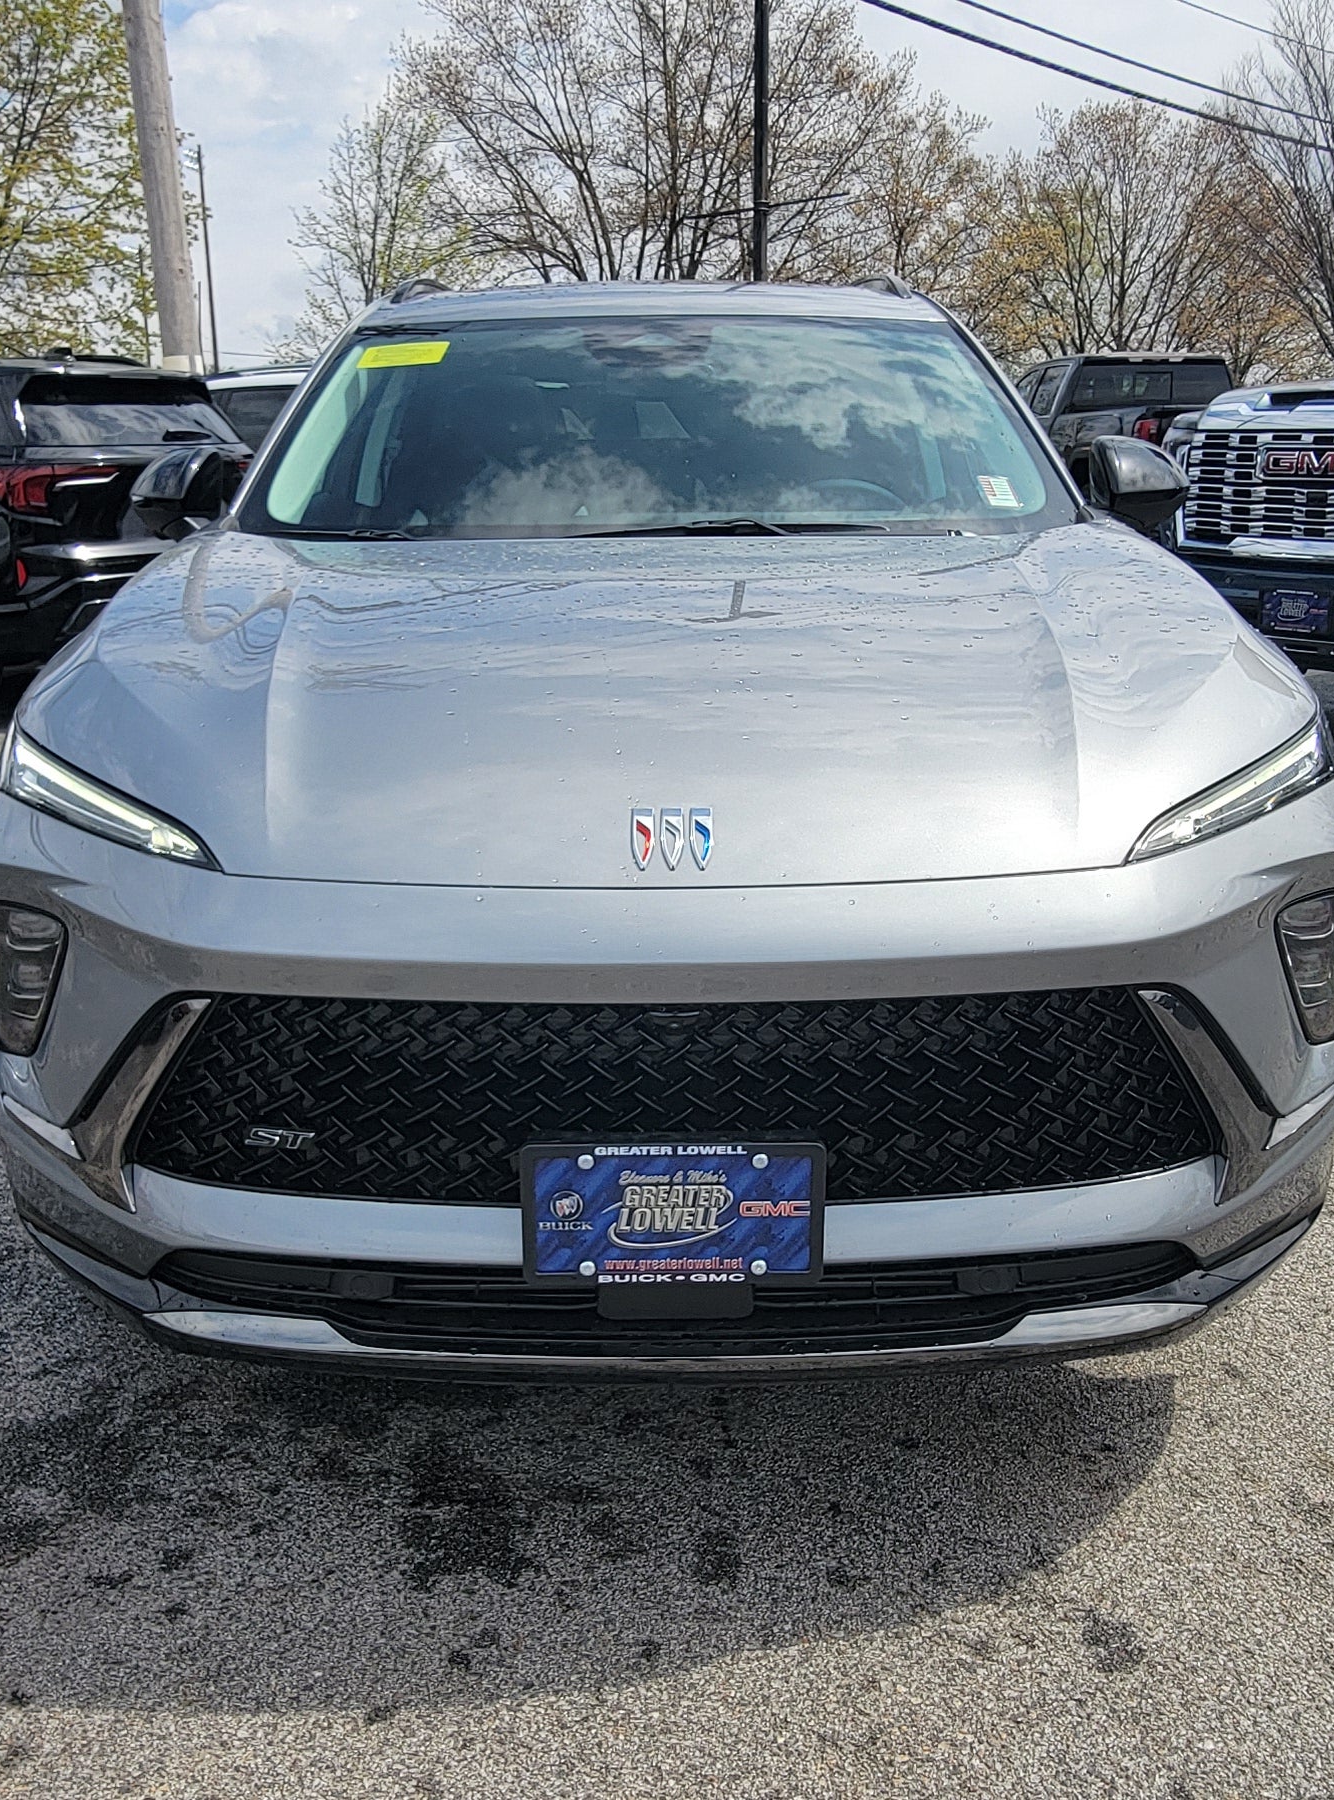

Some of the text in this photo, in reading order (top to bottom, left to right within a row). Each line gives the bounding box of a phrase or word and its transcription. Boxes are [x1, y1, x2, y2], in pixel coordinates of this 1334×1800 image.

[244, 1127, 316, 1150] ST
[594, 1146, 748, 1156] GREATER LOWELL
[672, 1170, 684, 1184] &
[622, 1185, 727, 1209] GREATER
[739, 1200, 811, 1218] GMC
[538, 1221, 594, 1231] BUICK
[616, 1207, 721, 1234] LOWELL
[604, 1256, 744, 1272] www.greaterlowell.net
[597, 1273, 746, 1284] BUICK GMC
